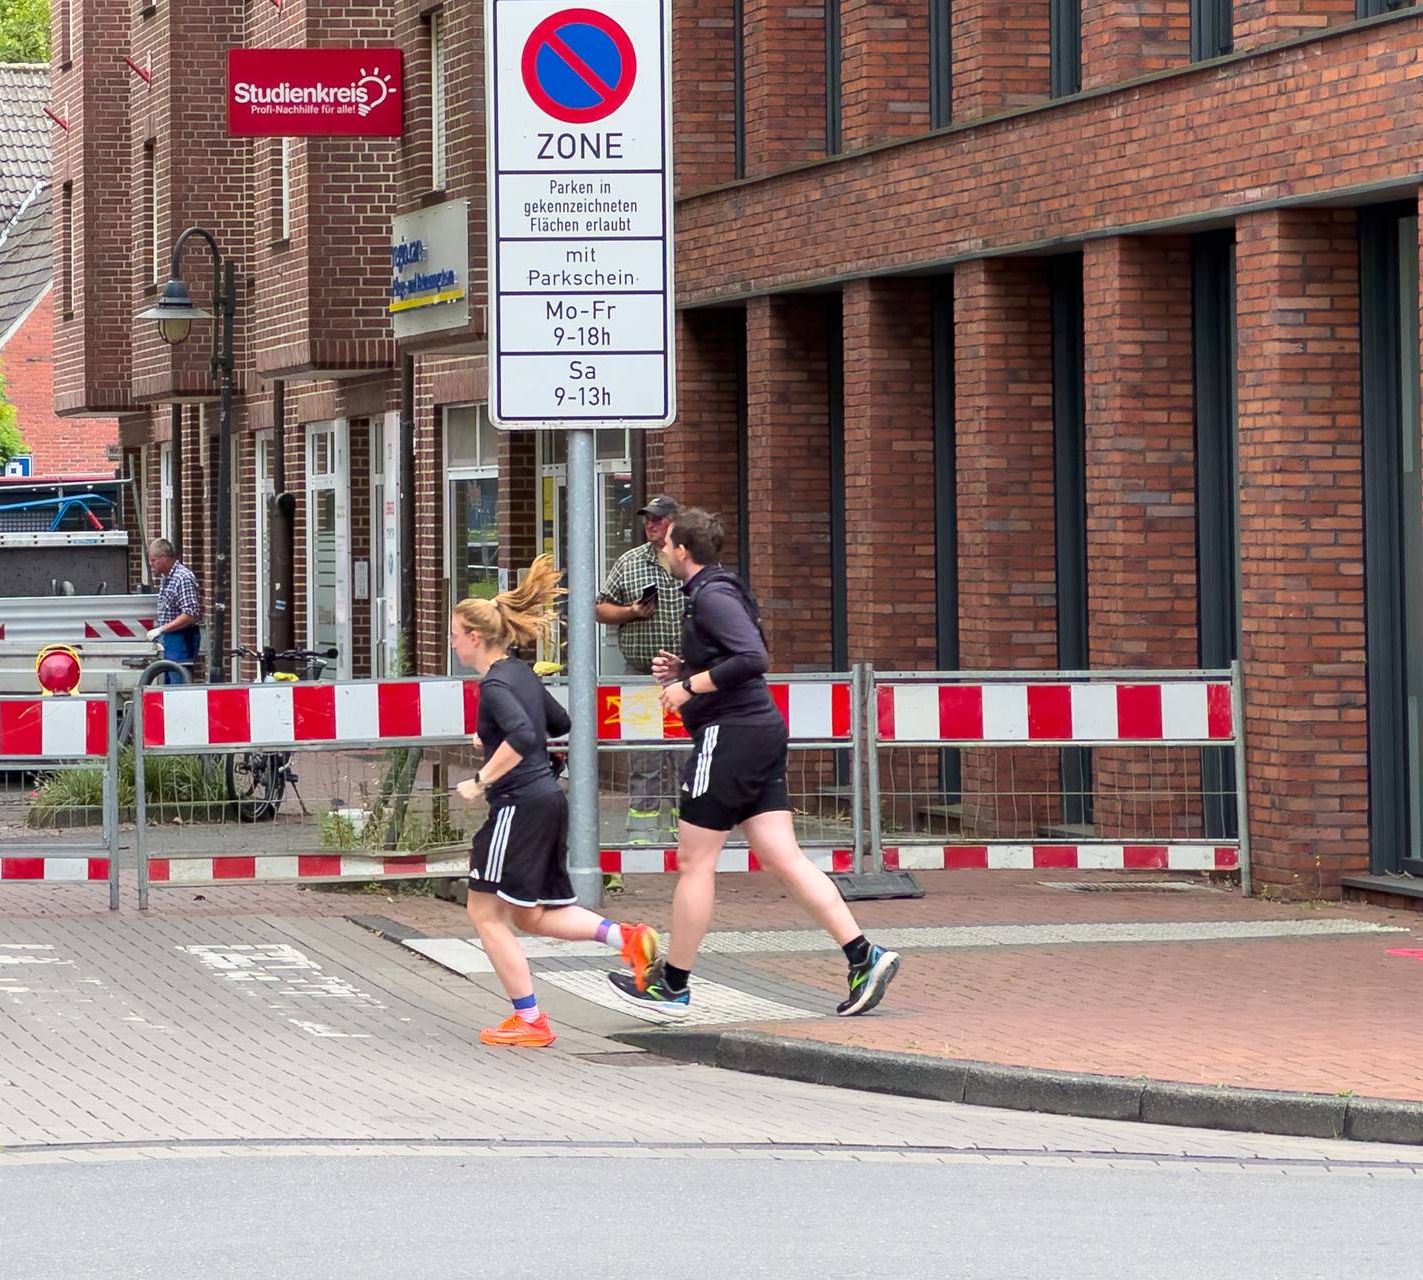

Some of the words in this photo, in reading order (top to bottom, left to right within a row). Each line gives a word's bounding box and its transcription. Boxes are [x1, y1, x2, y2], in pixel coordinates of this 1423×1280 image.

[234, 82, 368, 104] Studienkreis
[251, 105, 319, 114] Profi-Nachhilfe
[321, 105, 334, 114] für
[337, 105, 356, 114] alle!
[537, 133, 623, 160] ZONE
[549, 180, 594, 195] Parken
[600, 180, 611, 195] in
[524, 198, 638, 217] gekennzeichneten
[530, 217, 579, 232] Flächen
[586, 217, 631, 232] erlaubt
[566, 247, 596, 263] mit
[528, 270, 634, 286] Parkschein
[546, 301, 616, 321] Mo-Fr
[553, 327, 611, 346] 9-18h
[569, 361, 597, 380] Sa
[554, 387, 611, 406] 9-13h
